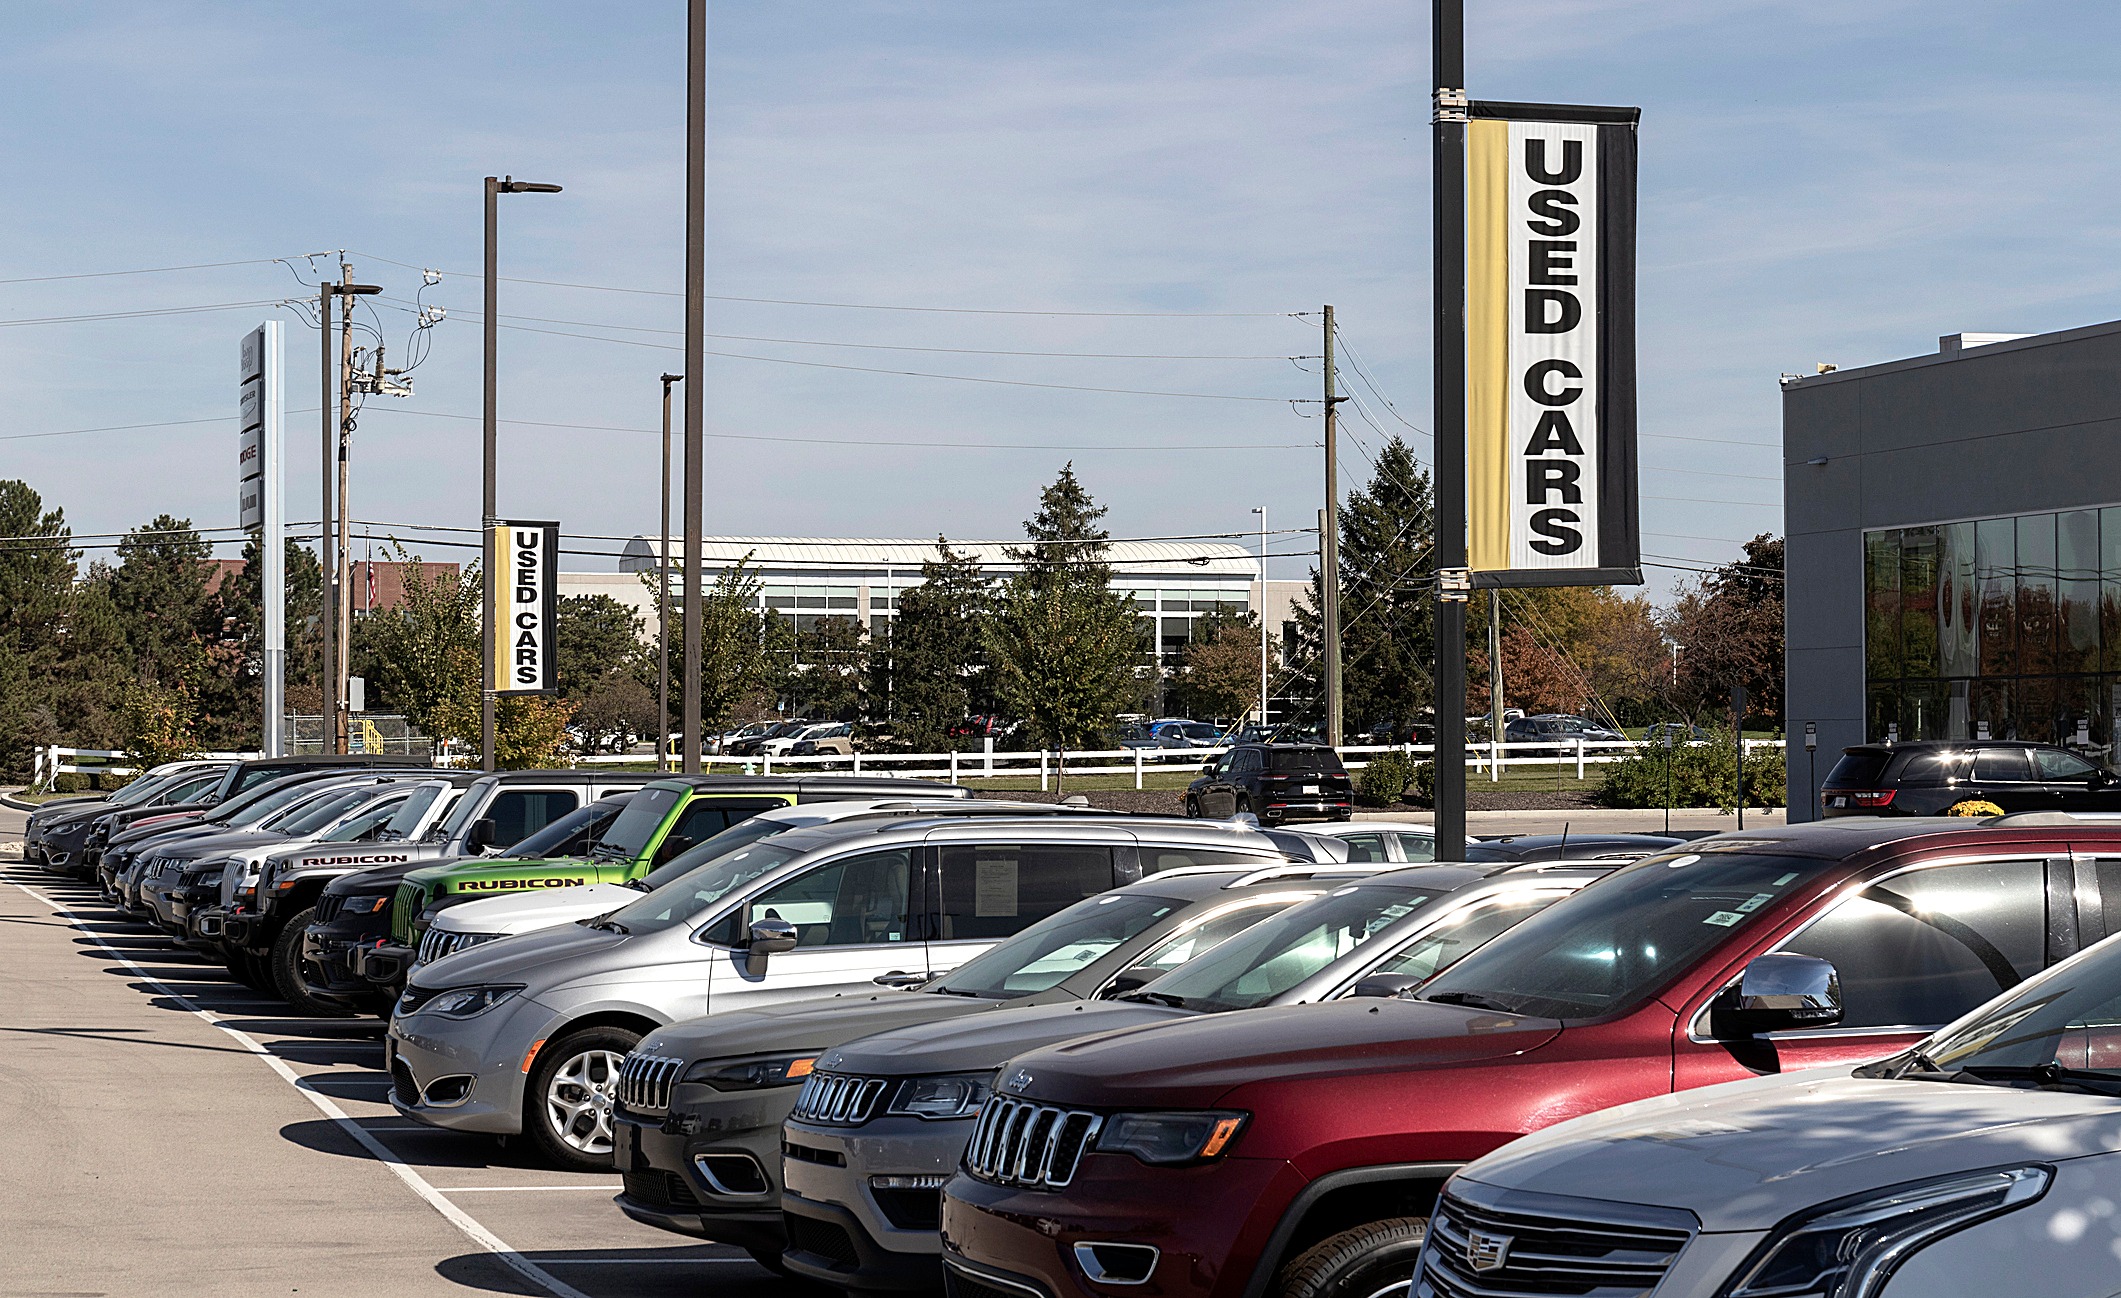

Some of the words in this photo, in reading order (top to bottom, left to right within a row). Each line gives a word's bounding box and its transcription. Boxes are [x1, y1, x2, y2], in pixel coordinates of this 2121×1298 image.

[1523, 138, 1583, 335] USED
[1523, 358, 1585, 556] CARS
[516, 531, 538, 604] USED
[515, 612, 538, 684] CARS
[302, 855, 408, 866] RUBICON
[458, 878, 584, 891] RUBICON
